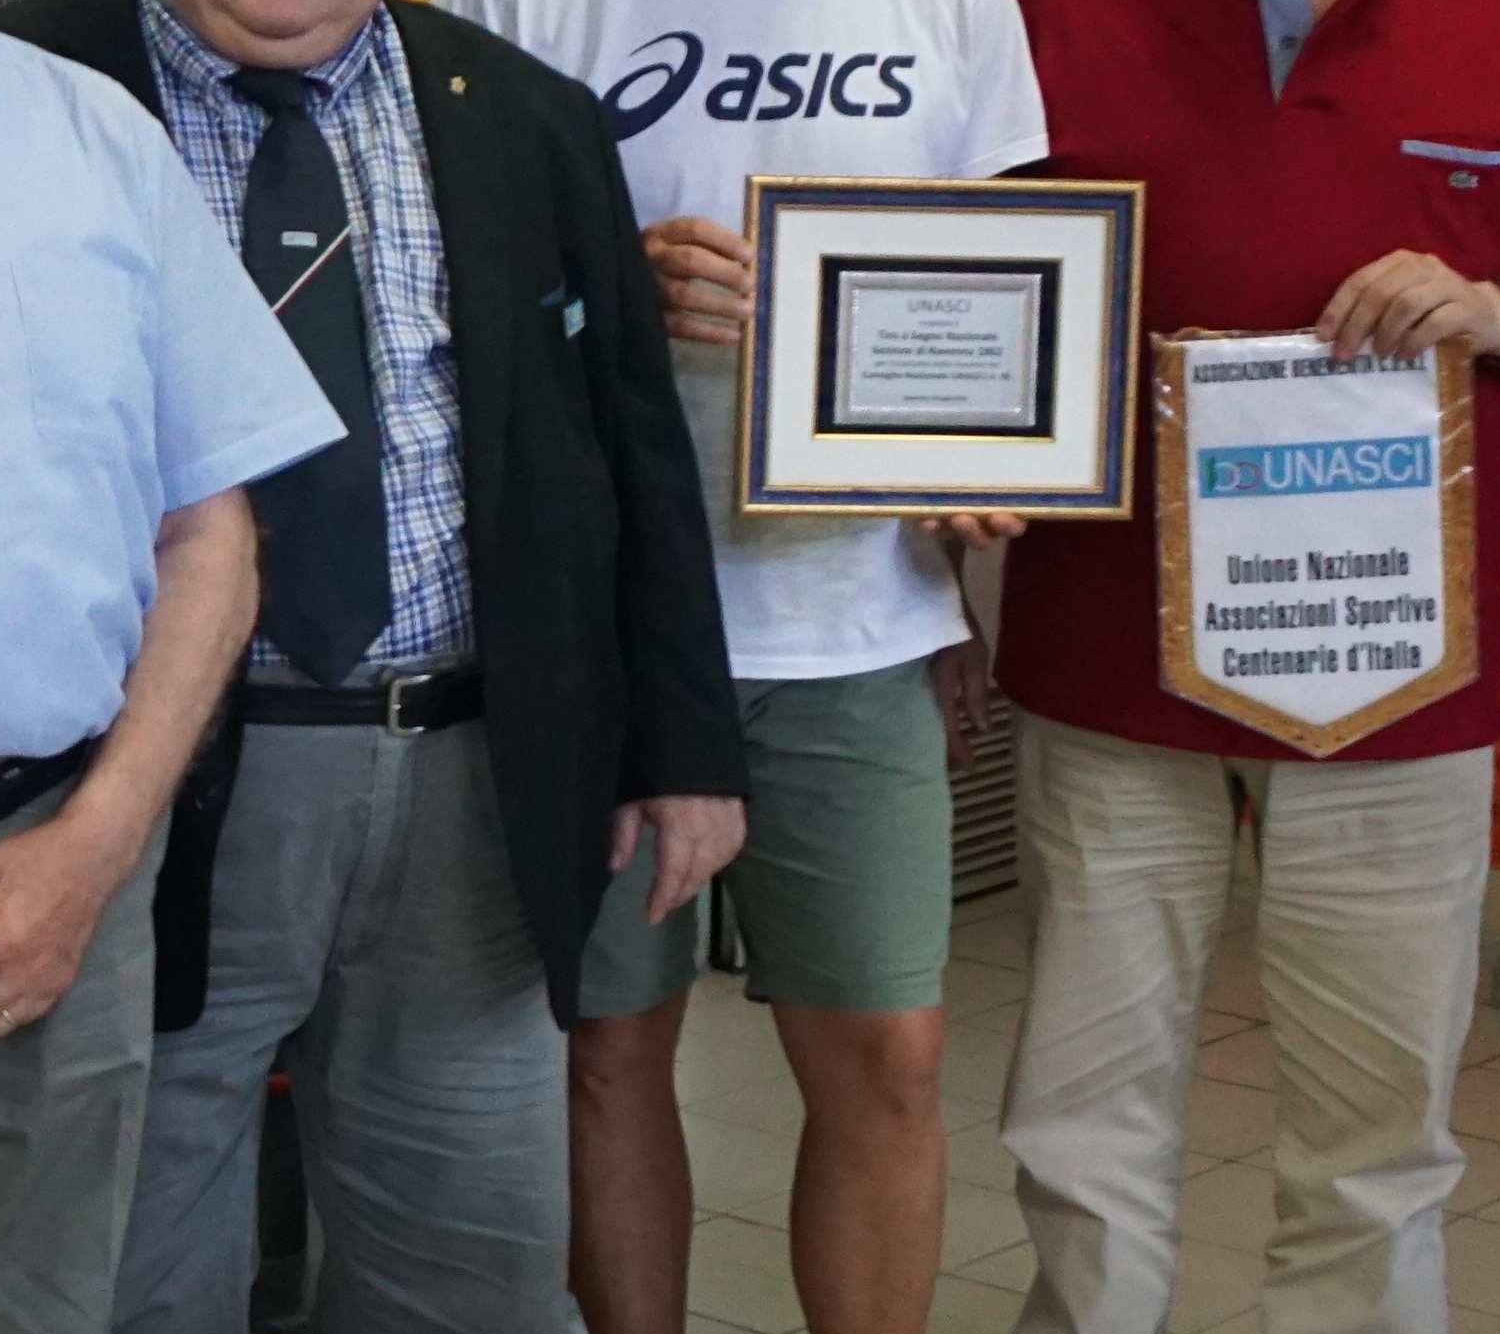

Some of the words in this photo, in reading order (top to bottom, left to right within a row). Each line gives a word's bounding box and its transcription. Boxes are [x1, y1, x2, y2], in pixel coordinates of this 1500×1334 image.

[906, 297, 972, 313] UNASCI
[1263, 441, 1425, 490] UNASCI
[1226, 554, 1298, 585] Unione
[1306, 546, 1410, 581] Nazionale
[1204, 598, 1338, 631] Associazioni
[1344, 593, 1437, 629] Sportive
[1222, 643, 1339, 677] Centenarie
[1347, 640, 1422, 672] d'Italia
